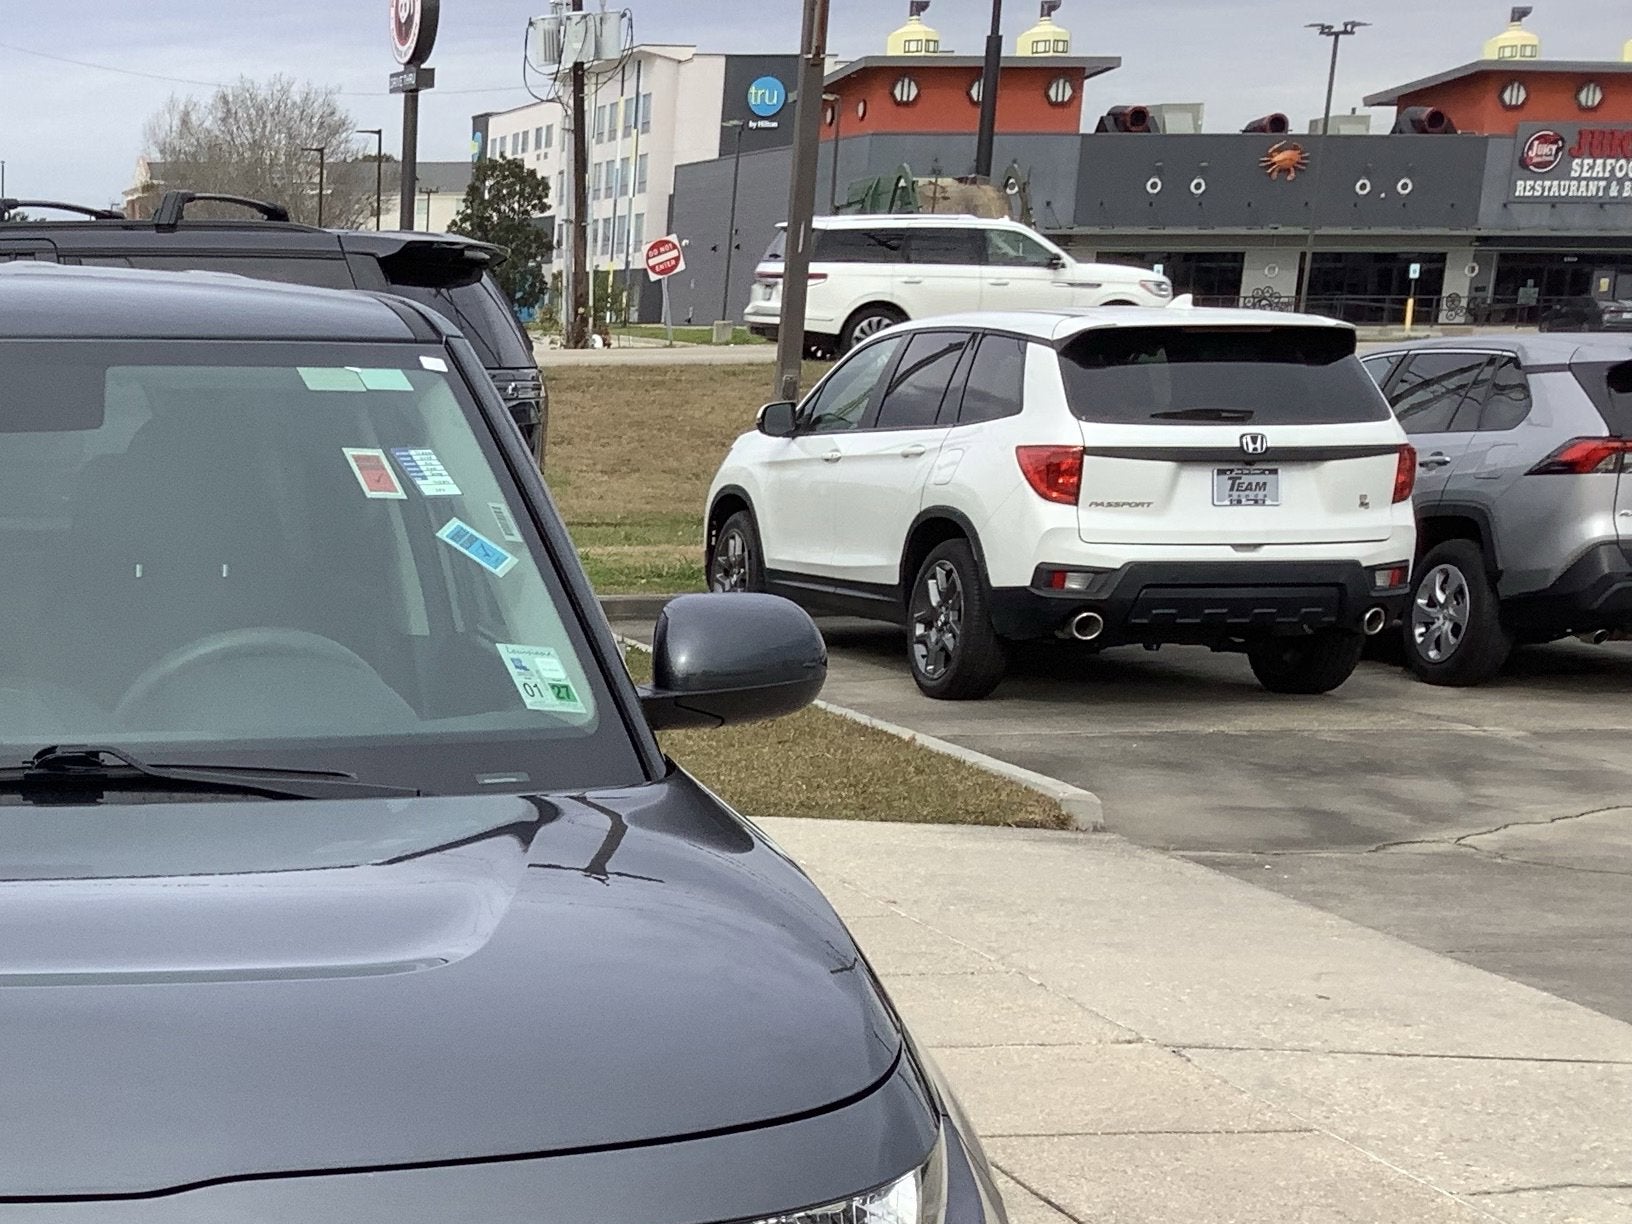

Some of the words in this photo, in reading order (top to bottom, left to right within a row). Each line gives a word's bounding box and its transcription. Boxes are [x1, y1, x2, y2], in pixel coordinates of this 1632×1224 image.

[749, 86, 778, 105] tru
[1570, 158, 1632, 178] SEAFO
[1515, 180, 1608, 197] RESTAURANT
[522, 682, 544, 698] 01
[550, 684, 571, 700] 27
